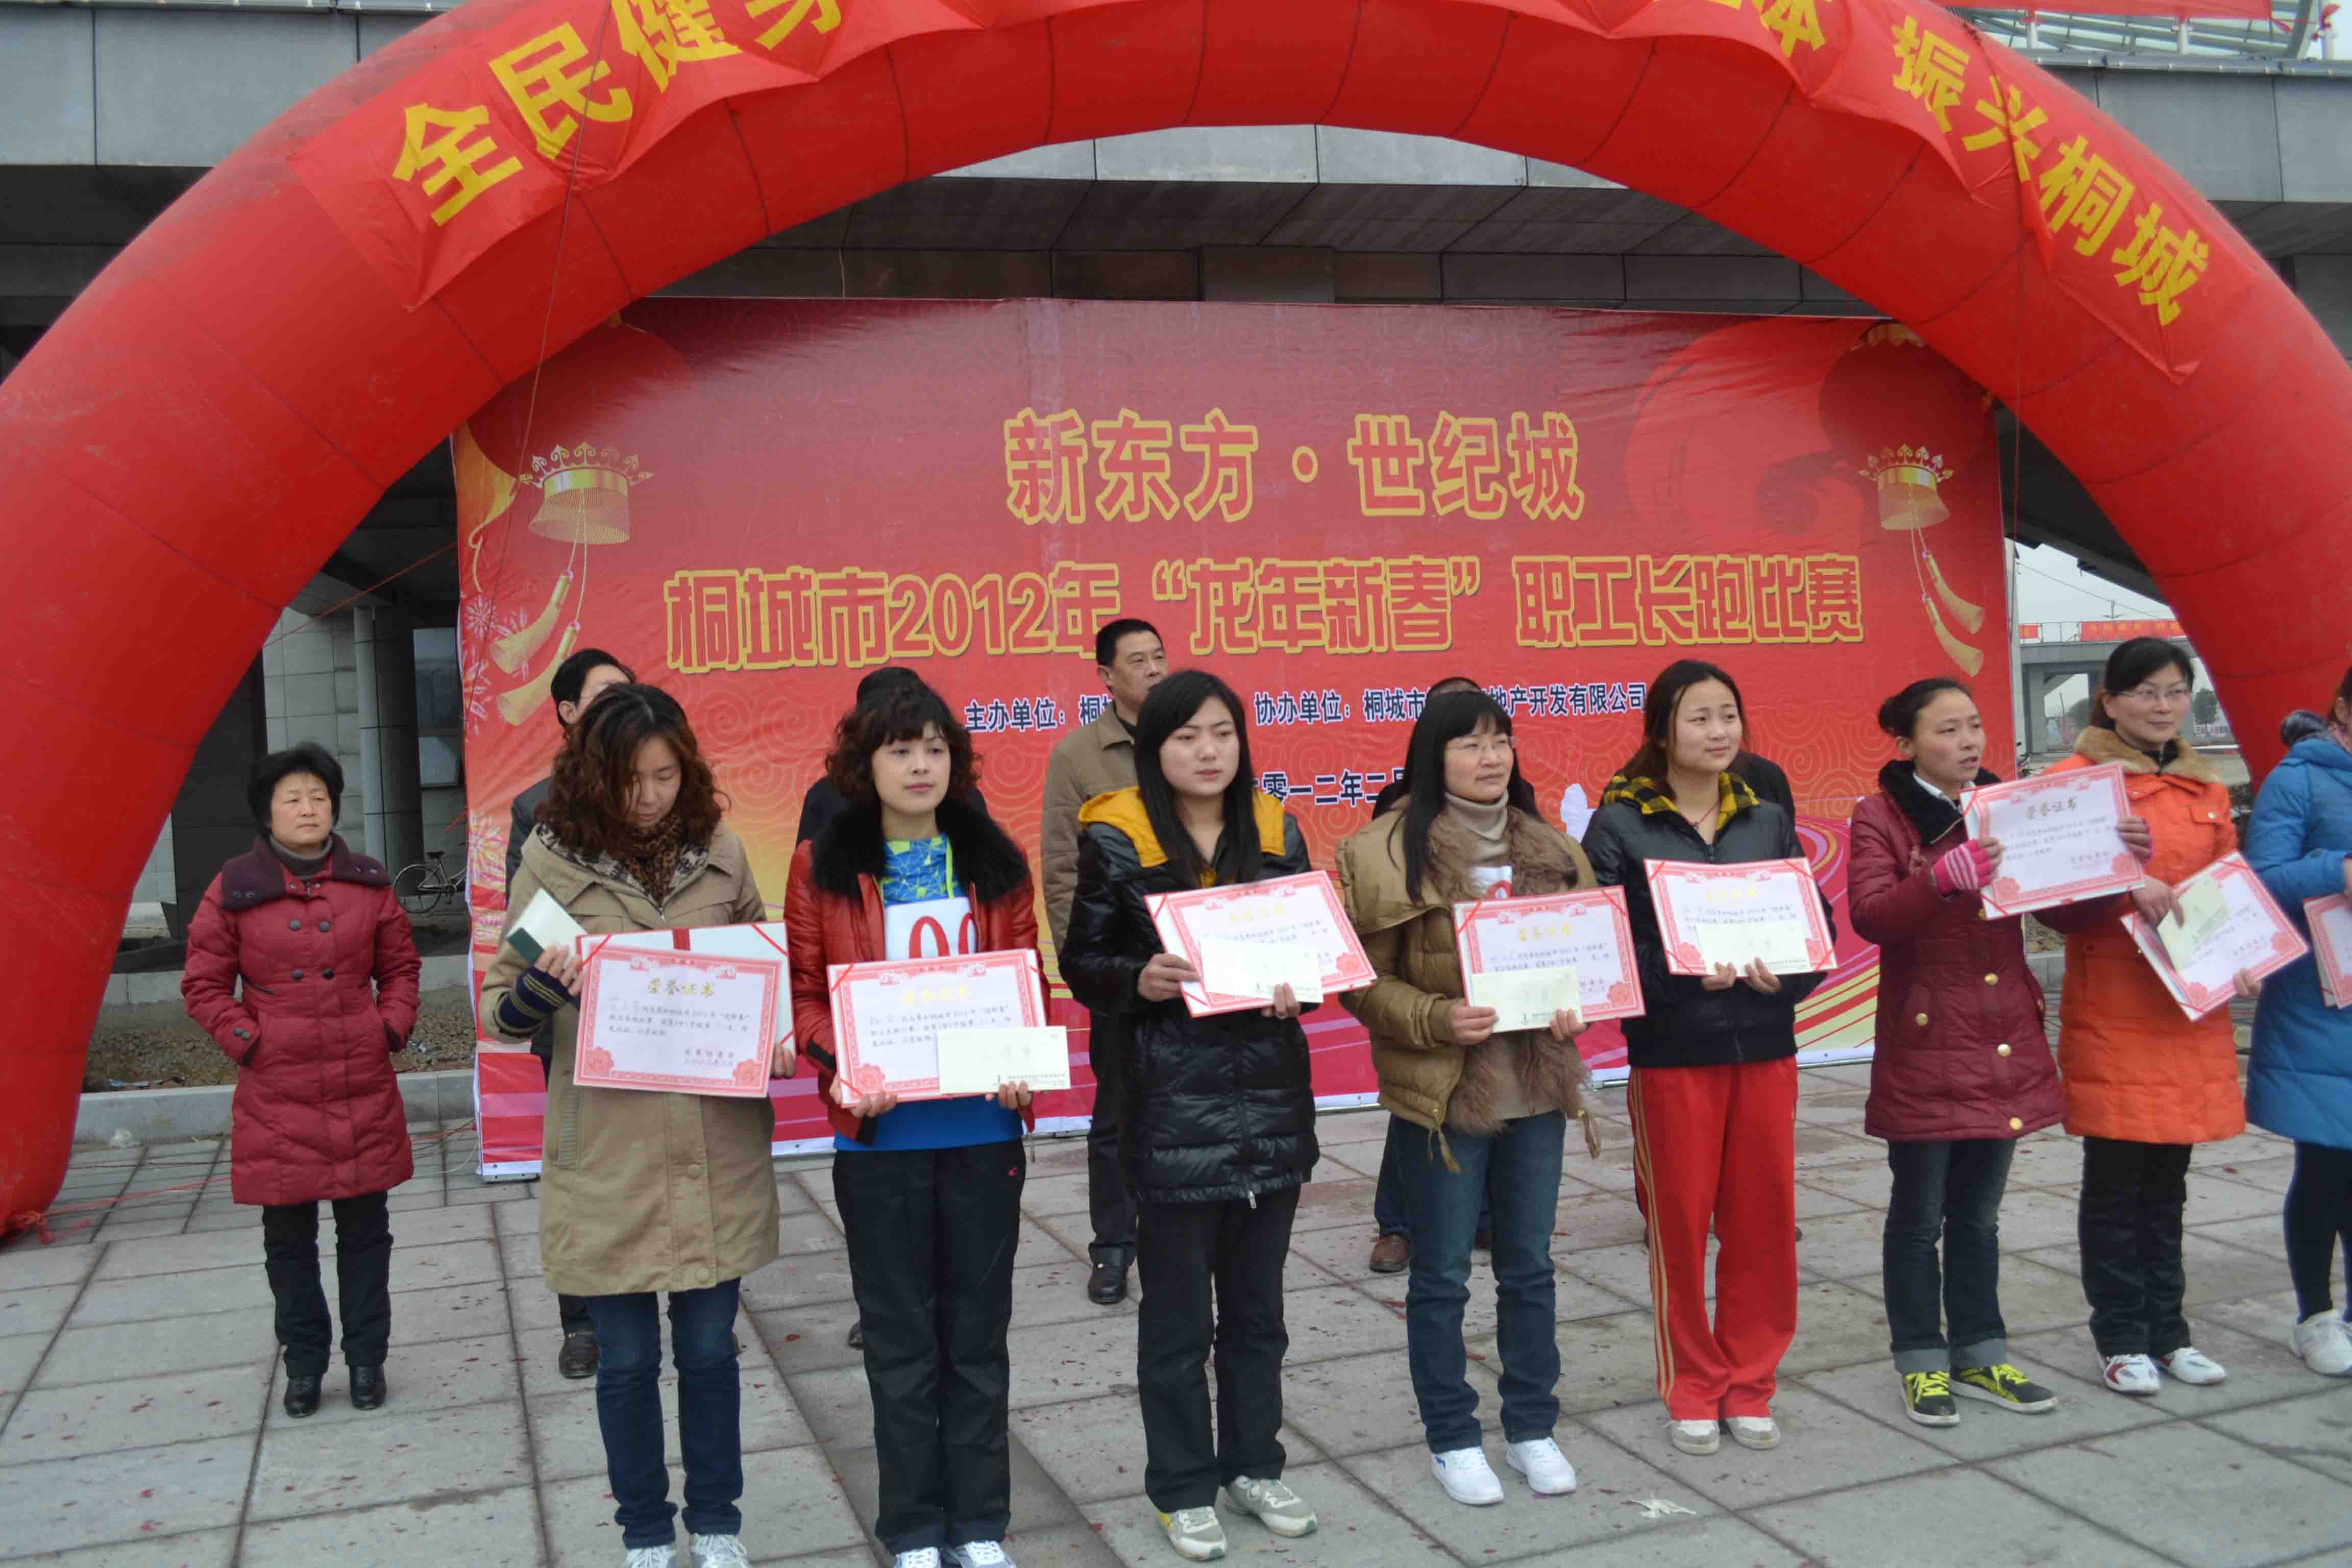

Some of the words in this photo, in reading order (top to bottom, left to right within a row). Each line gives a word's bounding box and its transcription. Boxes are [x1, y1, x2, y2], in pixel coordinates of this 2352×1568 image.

[1892, 15, 2209, 326] 振兴桐城
[1004, 407, 1585, 524] 新东方·世纪城
[664, 560, 1121, 674] 桐城市2012年
[1152, 555, 1481, 655] “龙年新春”
[1511, 553, 1863, 649] 职工长跑比赛
